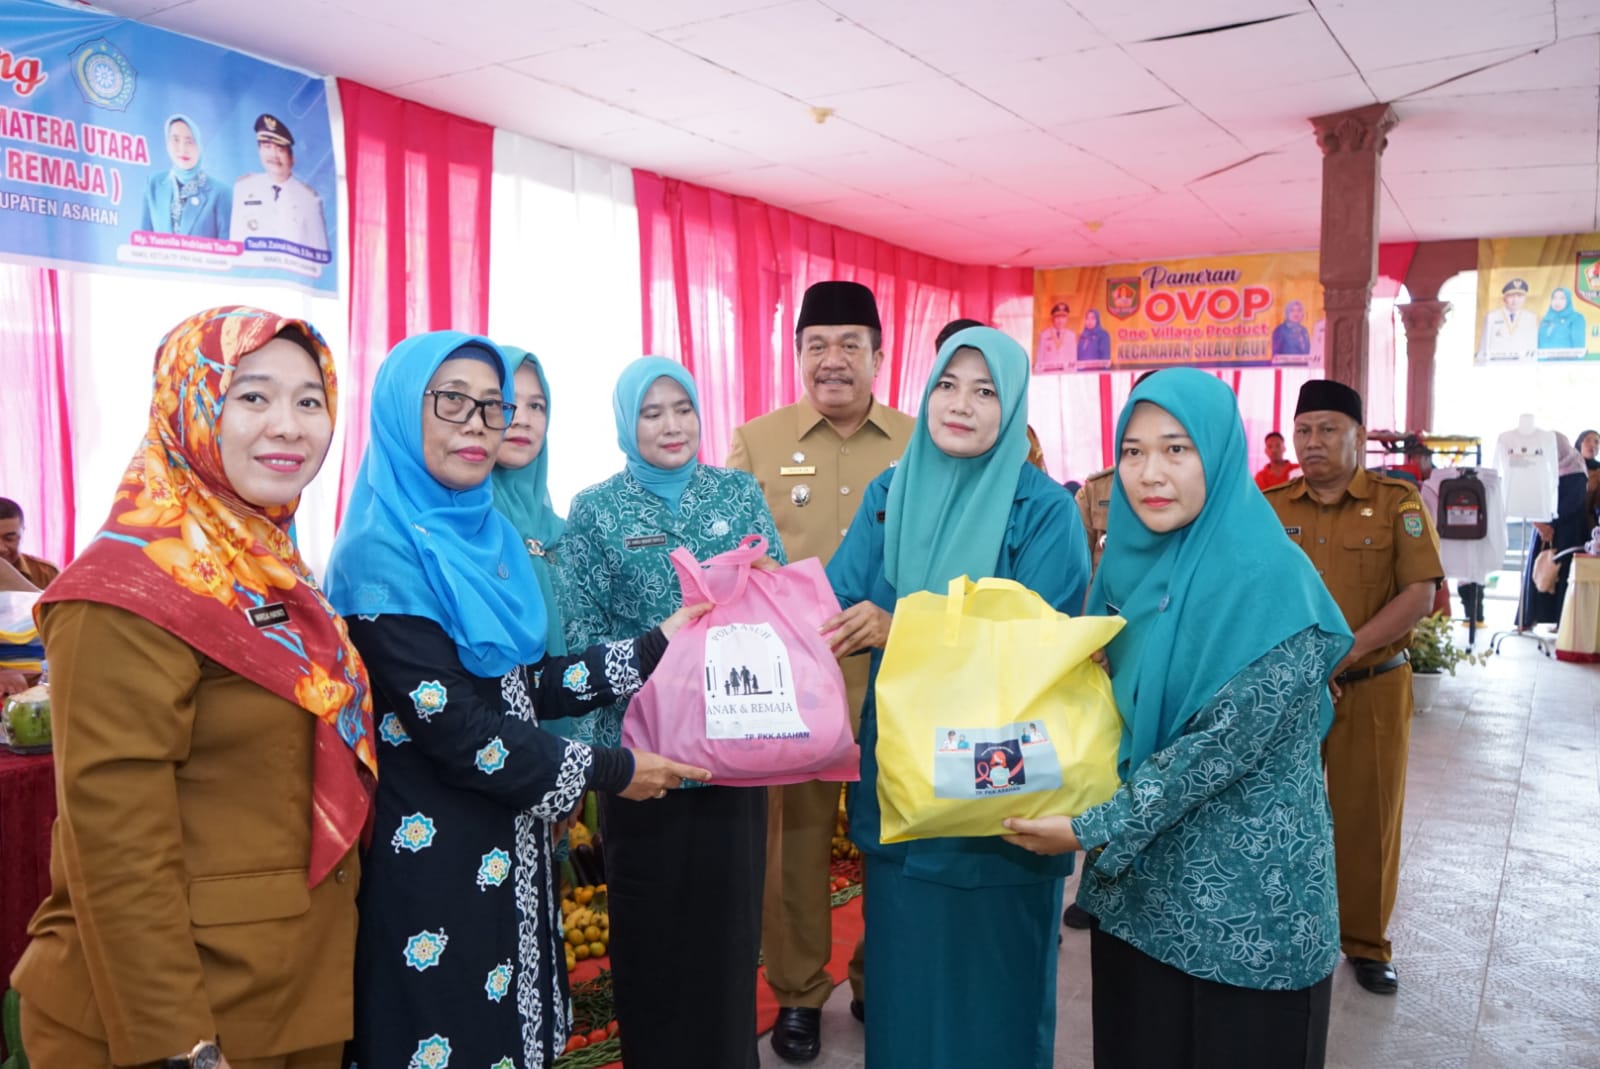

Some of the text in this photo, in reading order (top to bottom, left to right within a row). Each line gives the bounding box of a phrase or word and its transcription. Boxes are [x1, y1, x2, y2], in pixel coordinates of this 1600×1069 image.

[84, 126, 148, 163] UTARA
[7, 150, 105, 194] REMAJA
[62, 203, 118, 225] ASAHAN
[1142, 266, 1238, 289] Pameran
[1145, 287, 1270, 322] OVOP
[1117, 324, 1268, 340] One Village Product
[1117, 343, 1190, 359] KECAMATAN
[711, 624, 737, 641] POLA
[707, 702, 793, 715] ANAK & REMAJA
